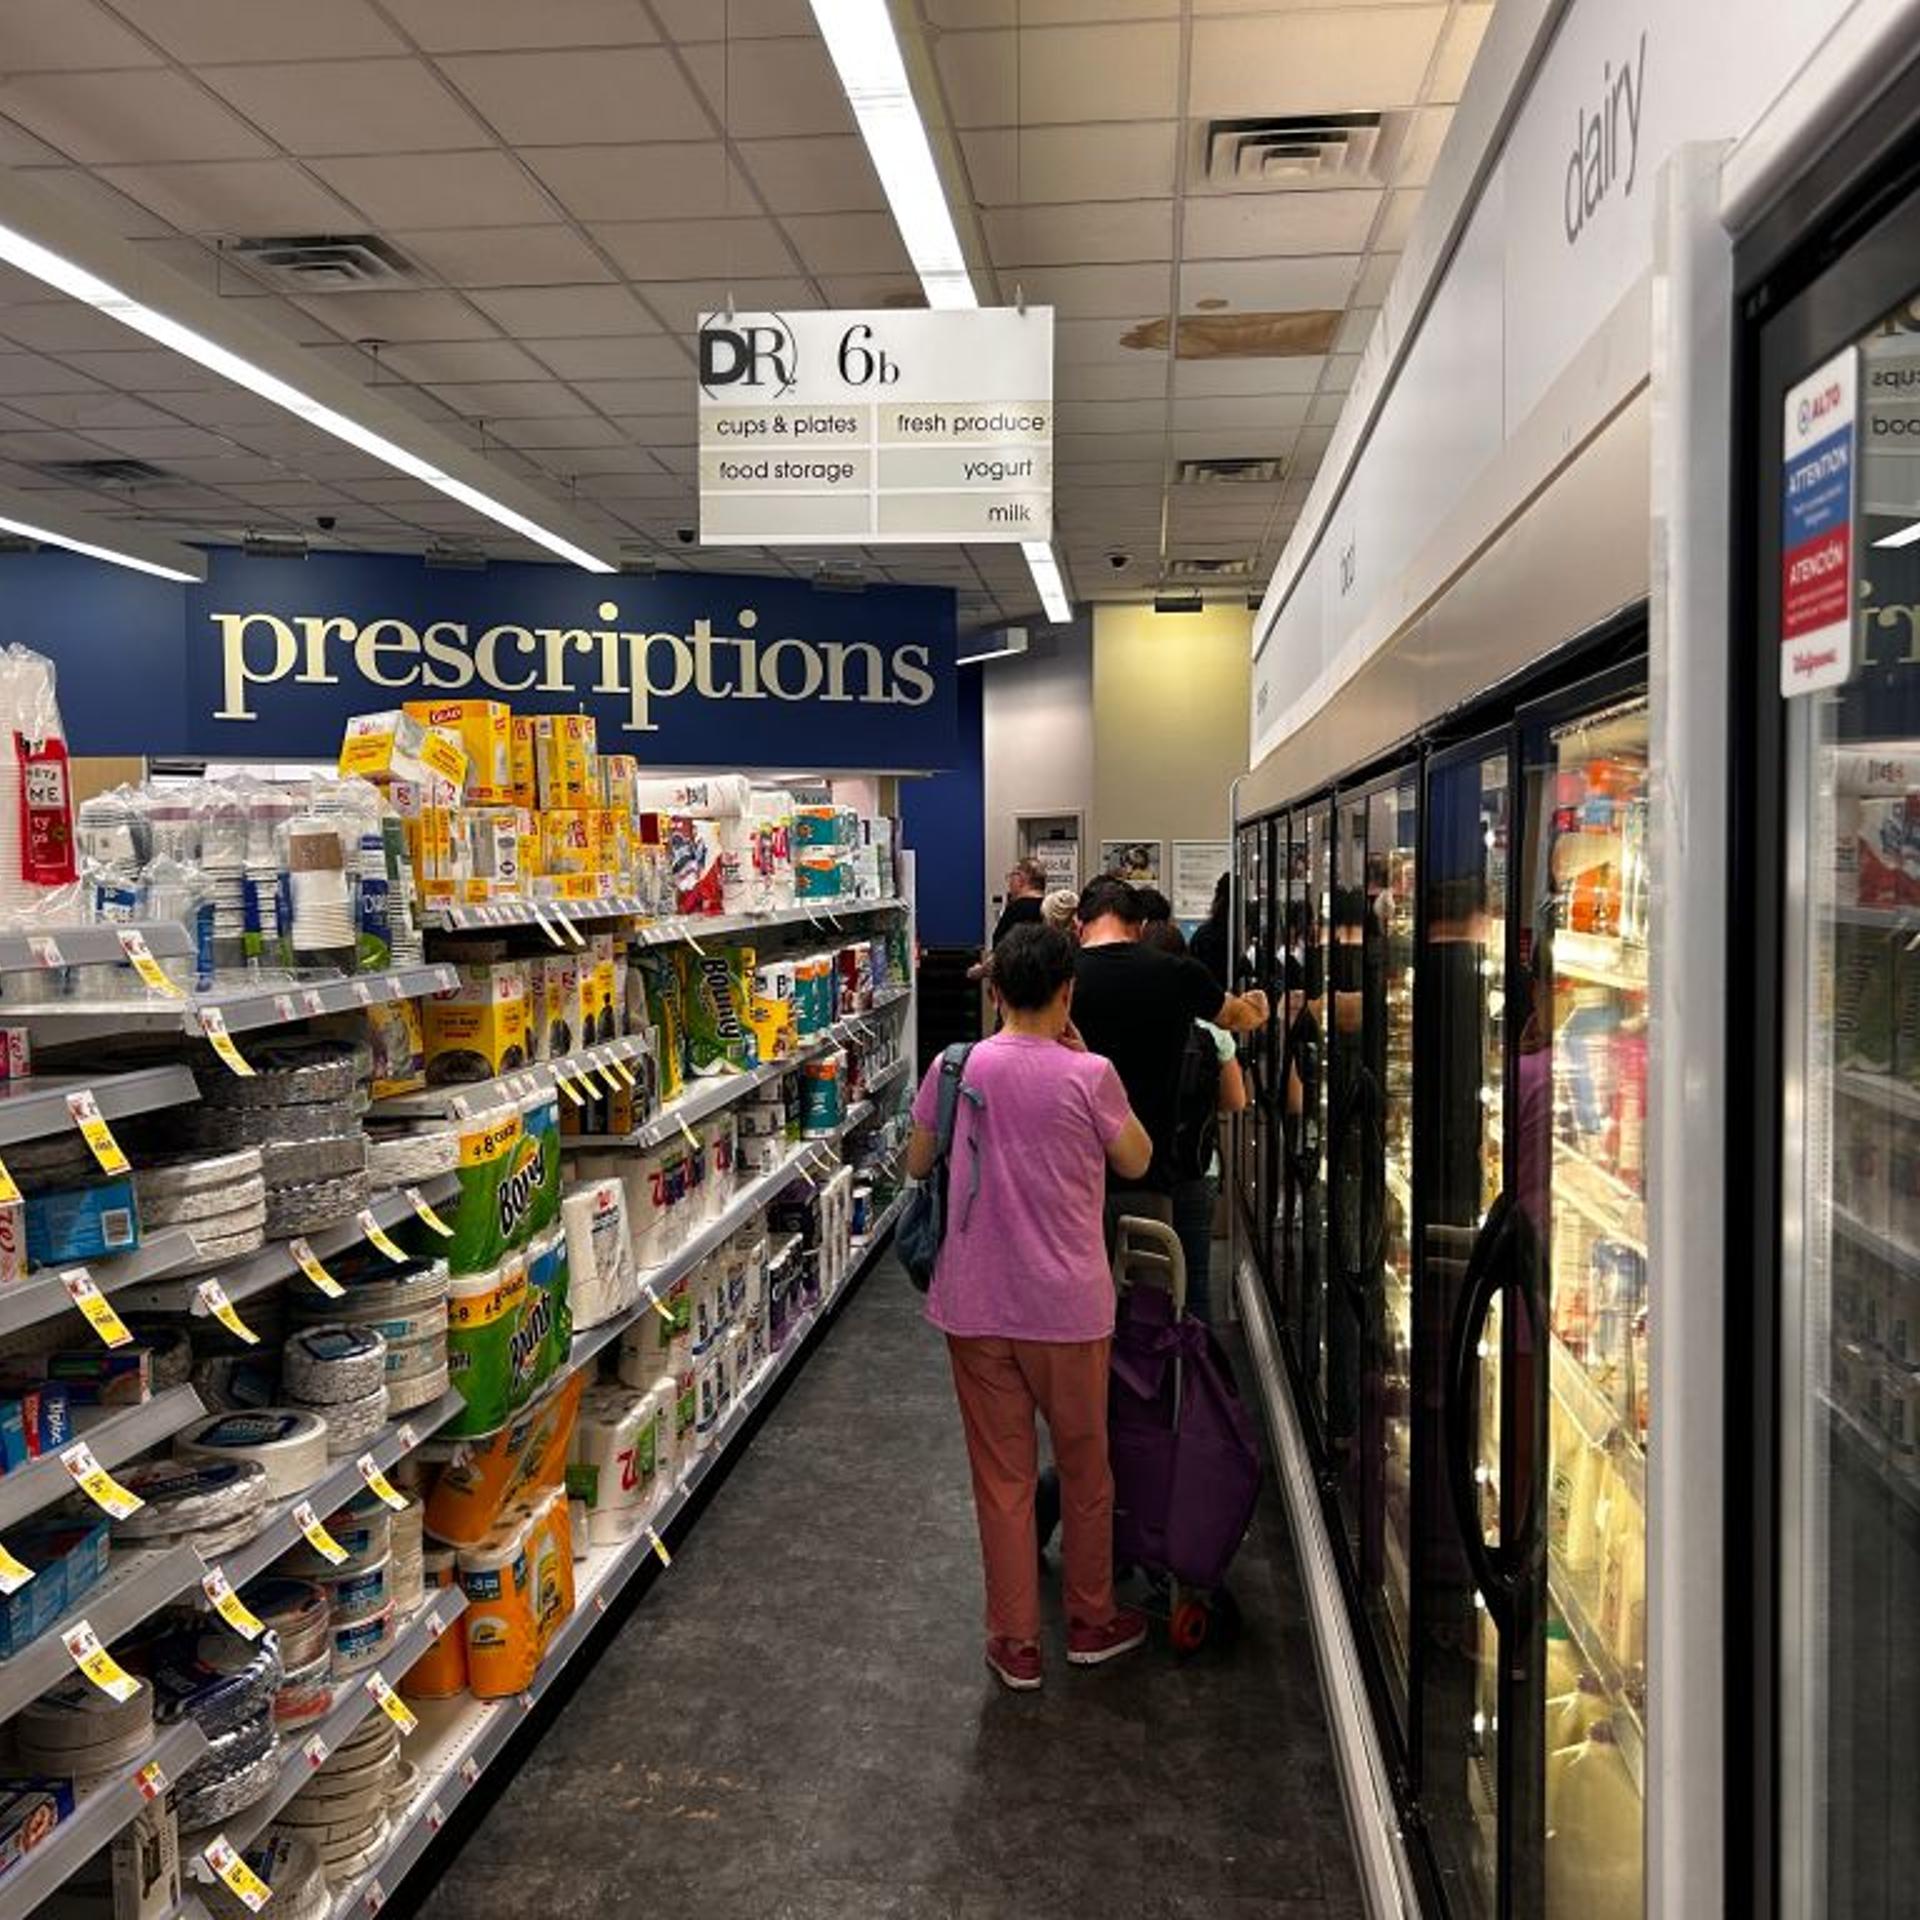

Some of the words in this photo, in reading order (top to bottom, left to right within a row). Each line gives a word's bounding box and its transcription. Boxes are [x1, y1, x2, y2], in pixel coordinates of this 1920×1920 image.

[1565, 31, 1646, 245] dairy
[717, 417, 767, 438] cups
[774, 417, 788, 433] &
[794, 414, 858, 438] plates
[898, 413, 946, 432] fresh
[953, 413, 1046, 437] produce
[720, 462, 768, 479] food
[774, 462, 854, 483] storage
[963, 458, 1034, 481] yogurt
[1788, 443, 1848, 494] ATTENTION
[988, 505, 1031, 522] milk
[210, 602, 937, 731] prescriptions
